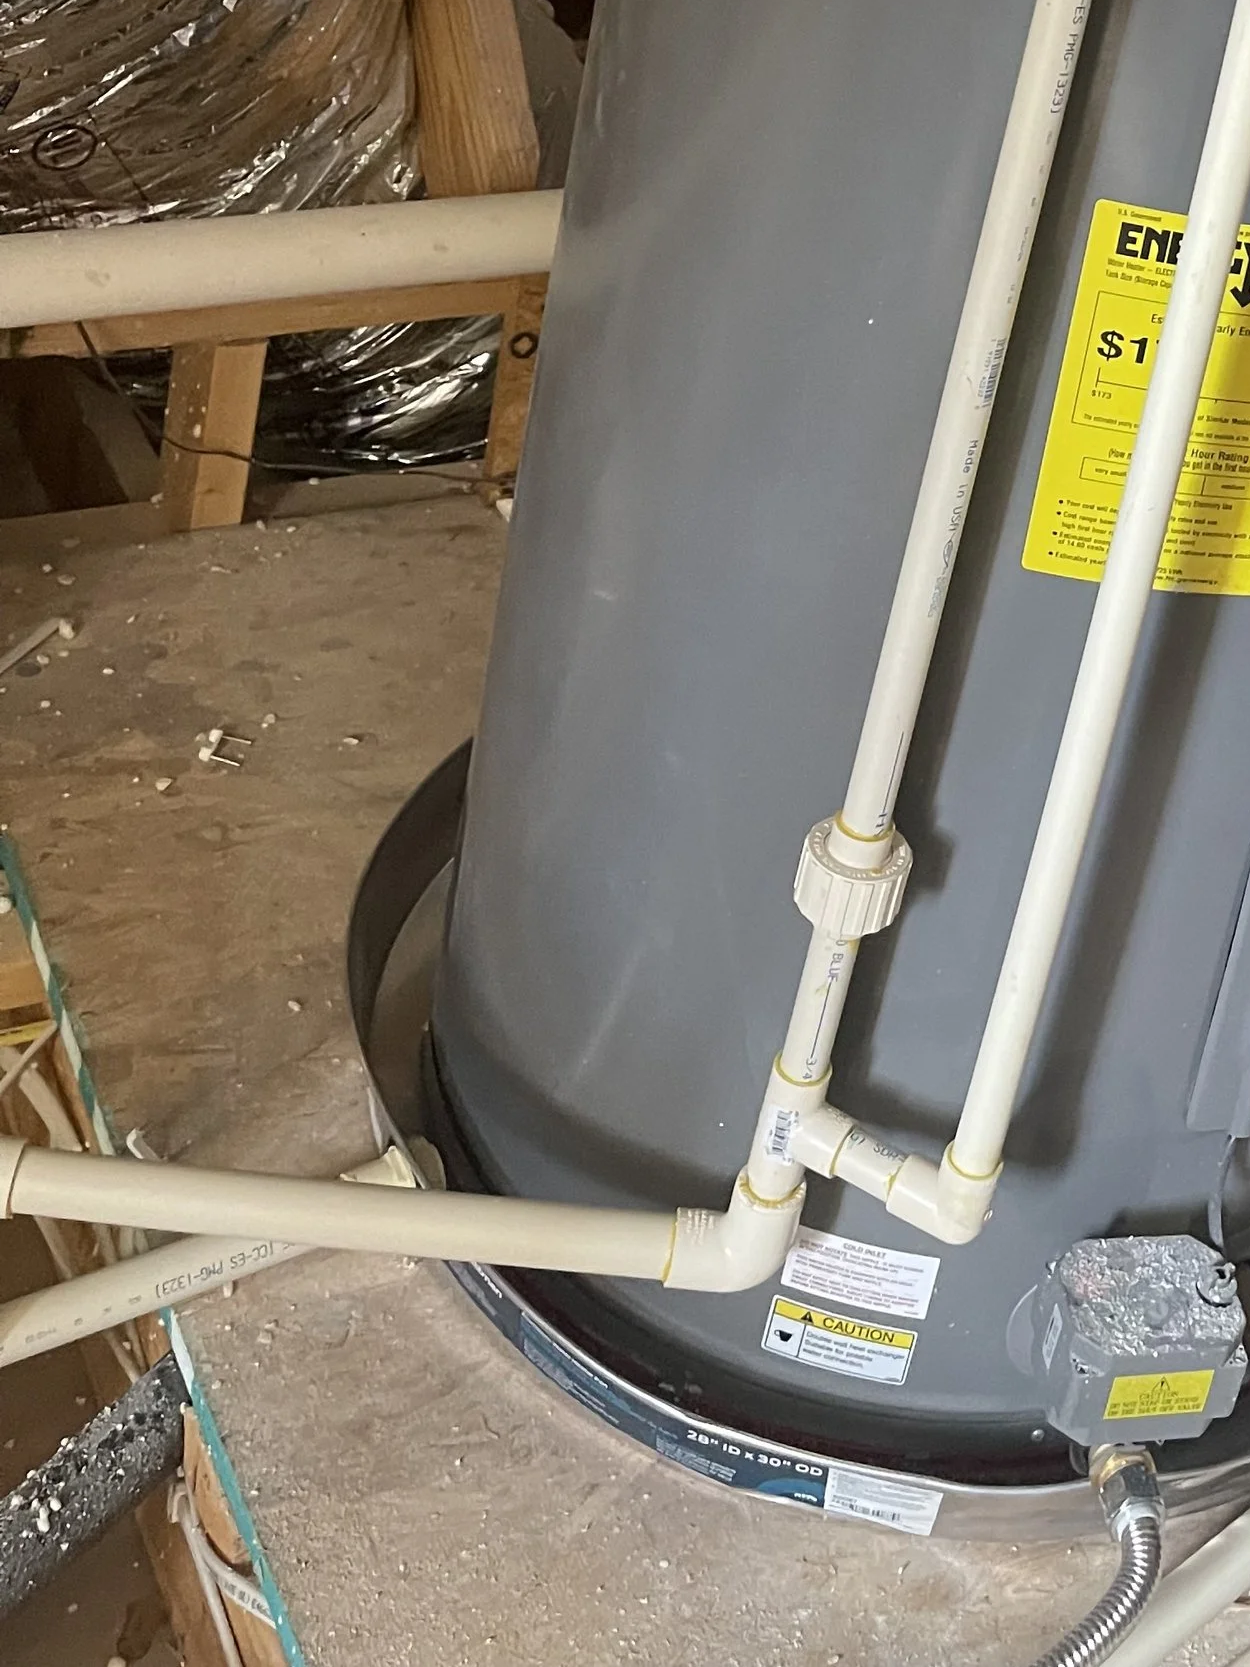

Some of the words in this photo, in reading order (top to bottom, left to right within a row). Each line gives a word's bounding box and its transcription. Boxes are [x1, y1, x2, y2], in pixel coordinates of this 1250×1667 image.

[1090, 389, 1112, 399] $173
[962, 440, 979, 474] Made
[1190, 449, 1214, 459] Hour
[1217, 451, 1250, 462] Rating
[947, 506, 963, 532] USA
[802, 1058, 817, 1080] 3/4
[229, 1240, 274, 1269] ICC-ES
[842, 1242, 864, 1253] COLD
[863, 1248, 886, 1259] INLET
[155, 1261, 225, 1299] PMG-1323)
[823, 1318, 895, 1343] CAUTION
[805, 1330, 832, 1343] Double
[849, 1342, 865, 1352] heat
[867, 1347, 903, 1361] exchanger
[688, 1430, 718, 1445] 28"
[722, 1443, 741, 1456] ID
[744, 1452, 754, 1461] x
[757, 1454, 792, 1468] 30"
[795, 1463, 824, 1477] OD
